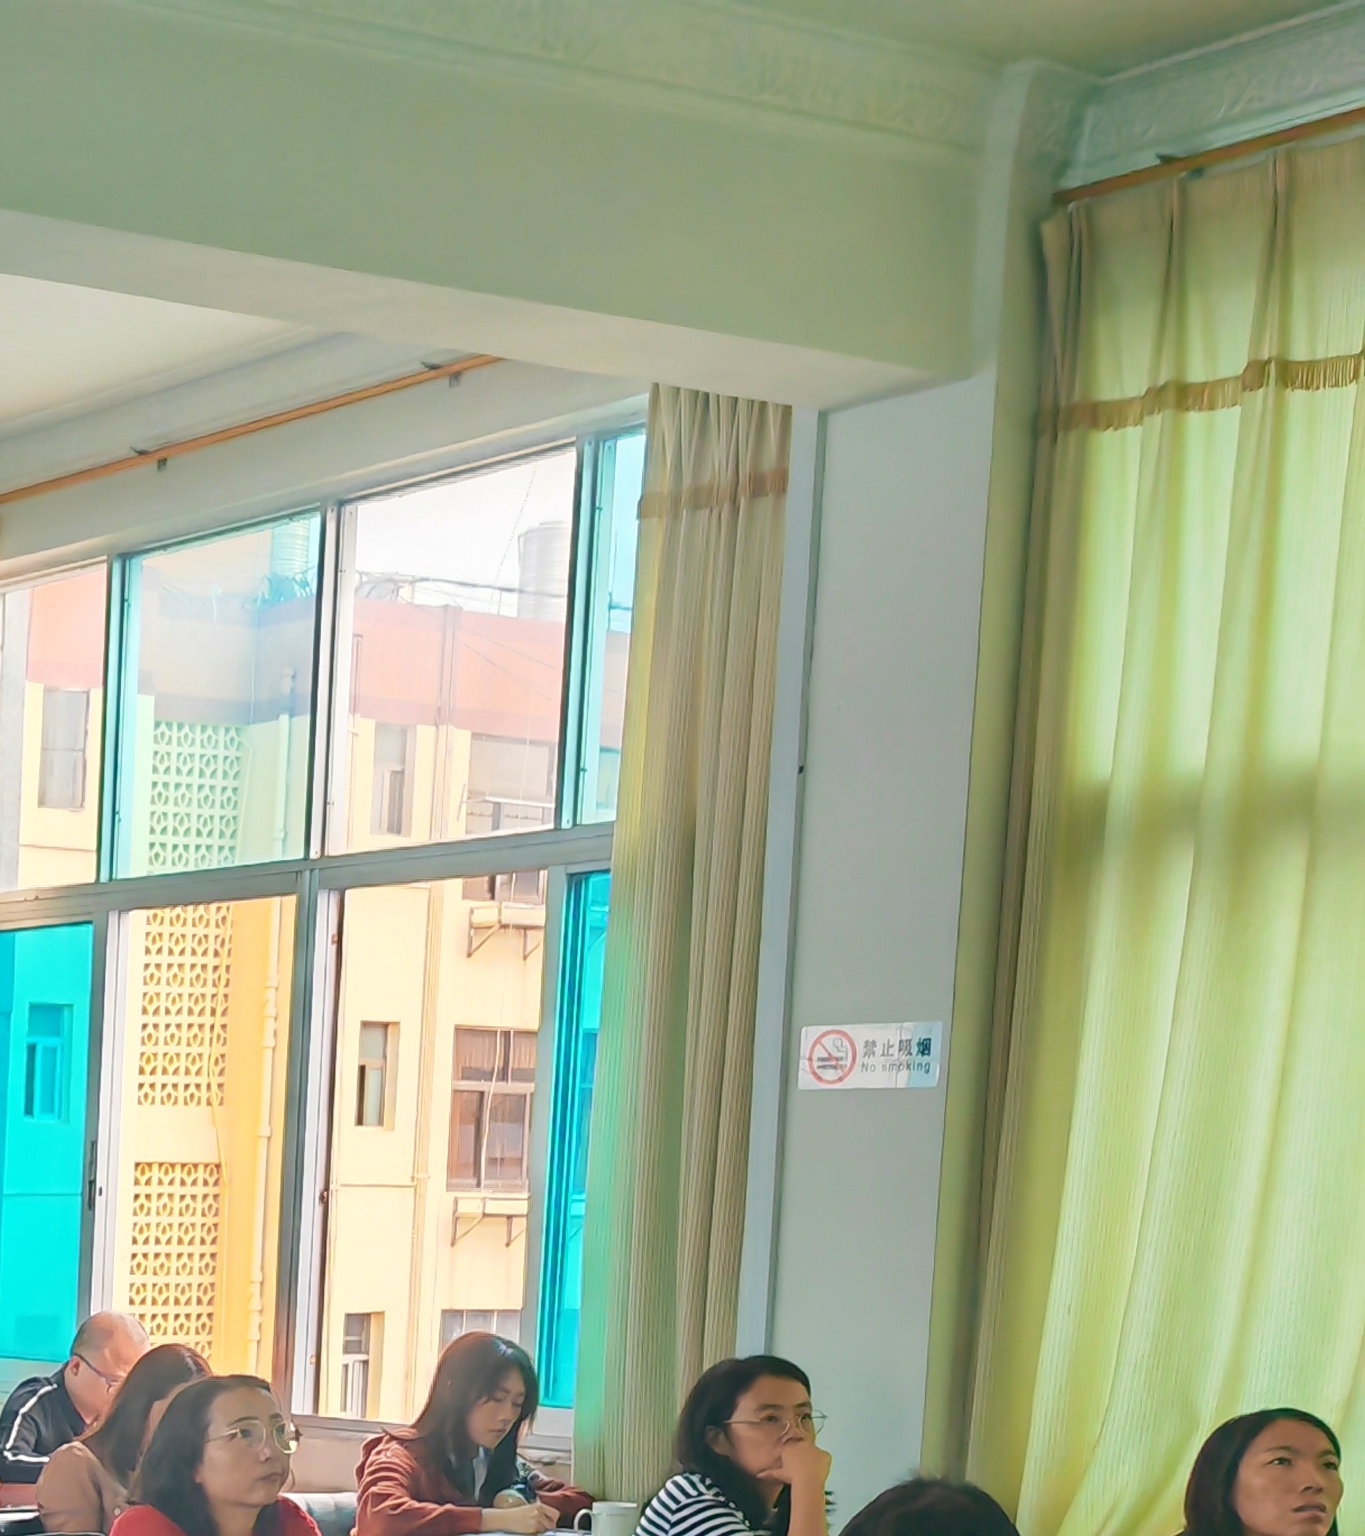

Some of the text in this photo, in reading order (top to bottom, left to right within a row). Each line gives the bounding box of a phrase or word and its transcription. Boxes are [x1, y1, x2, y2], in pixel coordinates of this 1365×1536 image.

[862, 1037, 932, 1058] 禁止吸烟
[861, 1061, 931, 1074] No smoking
